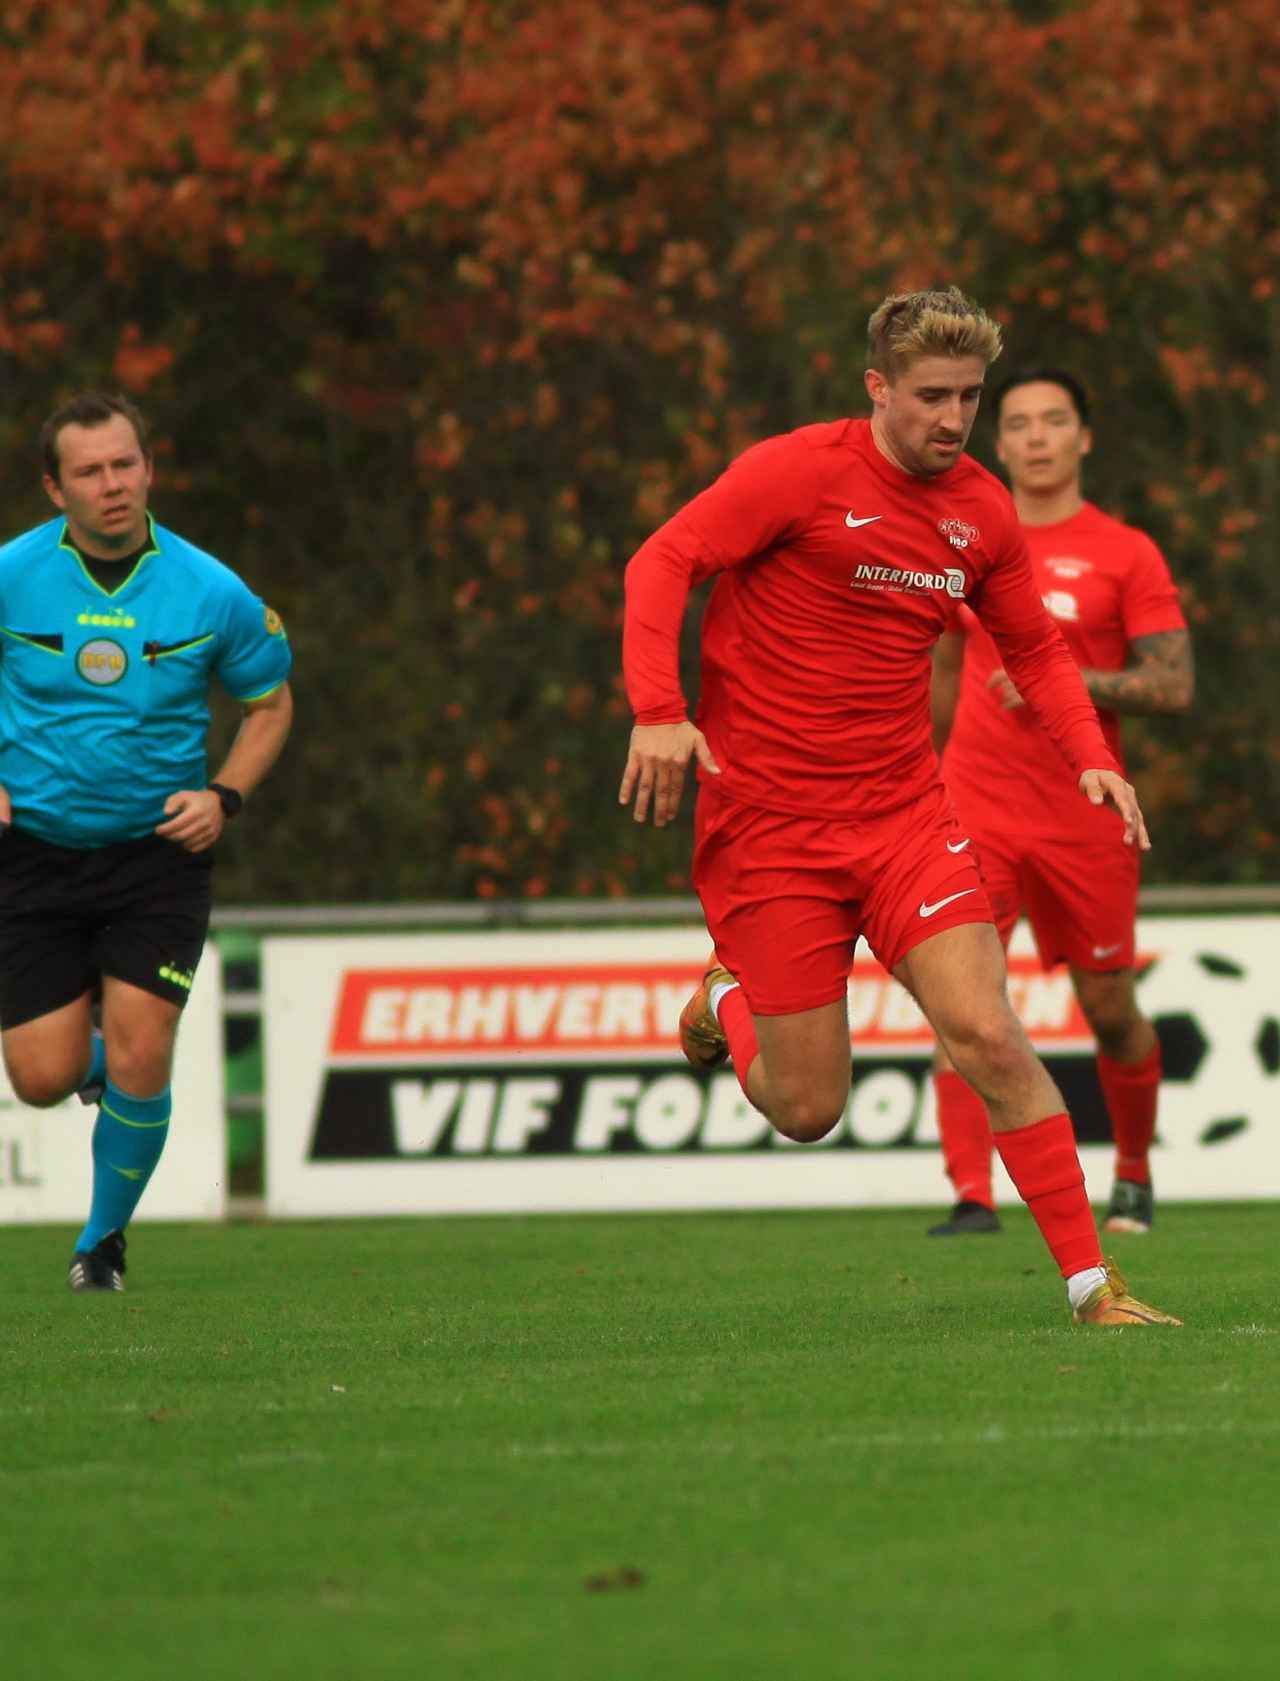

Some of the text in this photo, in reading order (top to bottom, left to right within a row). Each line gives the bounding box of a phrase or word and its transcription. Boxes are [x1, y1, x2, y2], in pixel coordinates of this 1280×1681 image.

[855, 564, 946, 589] INTERFJORD
[361, 974, 1073, 1043] ERHVERVUBN
[390, 1068, 941, 1153] VIF FODO
